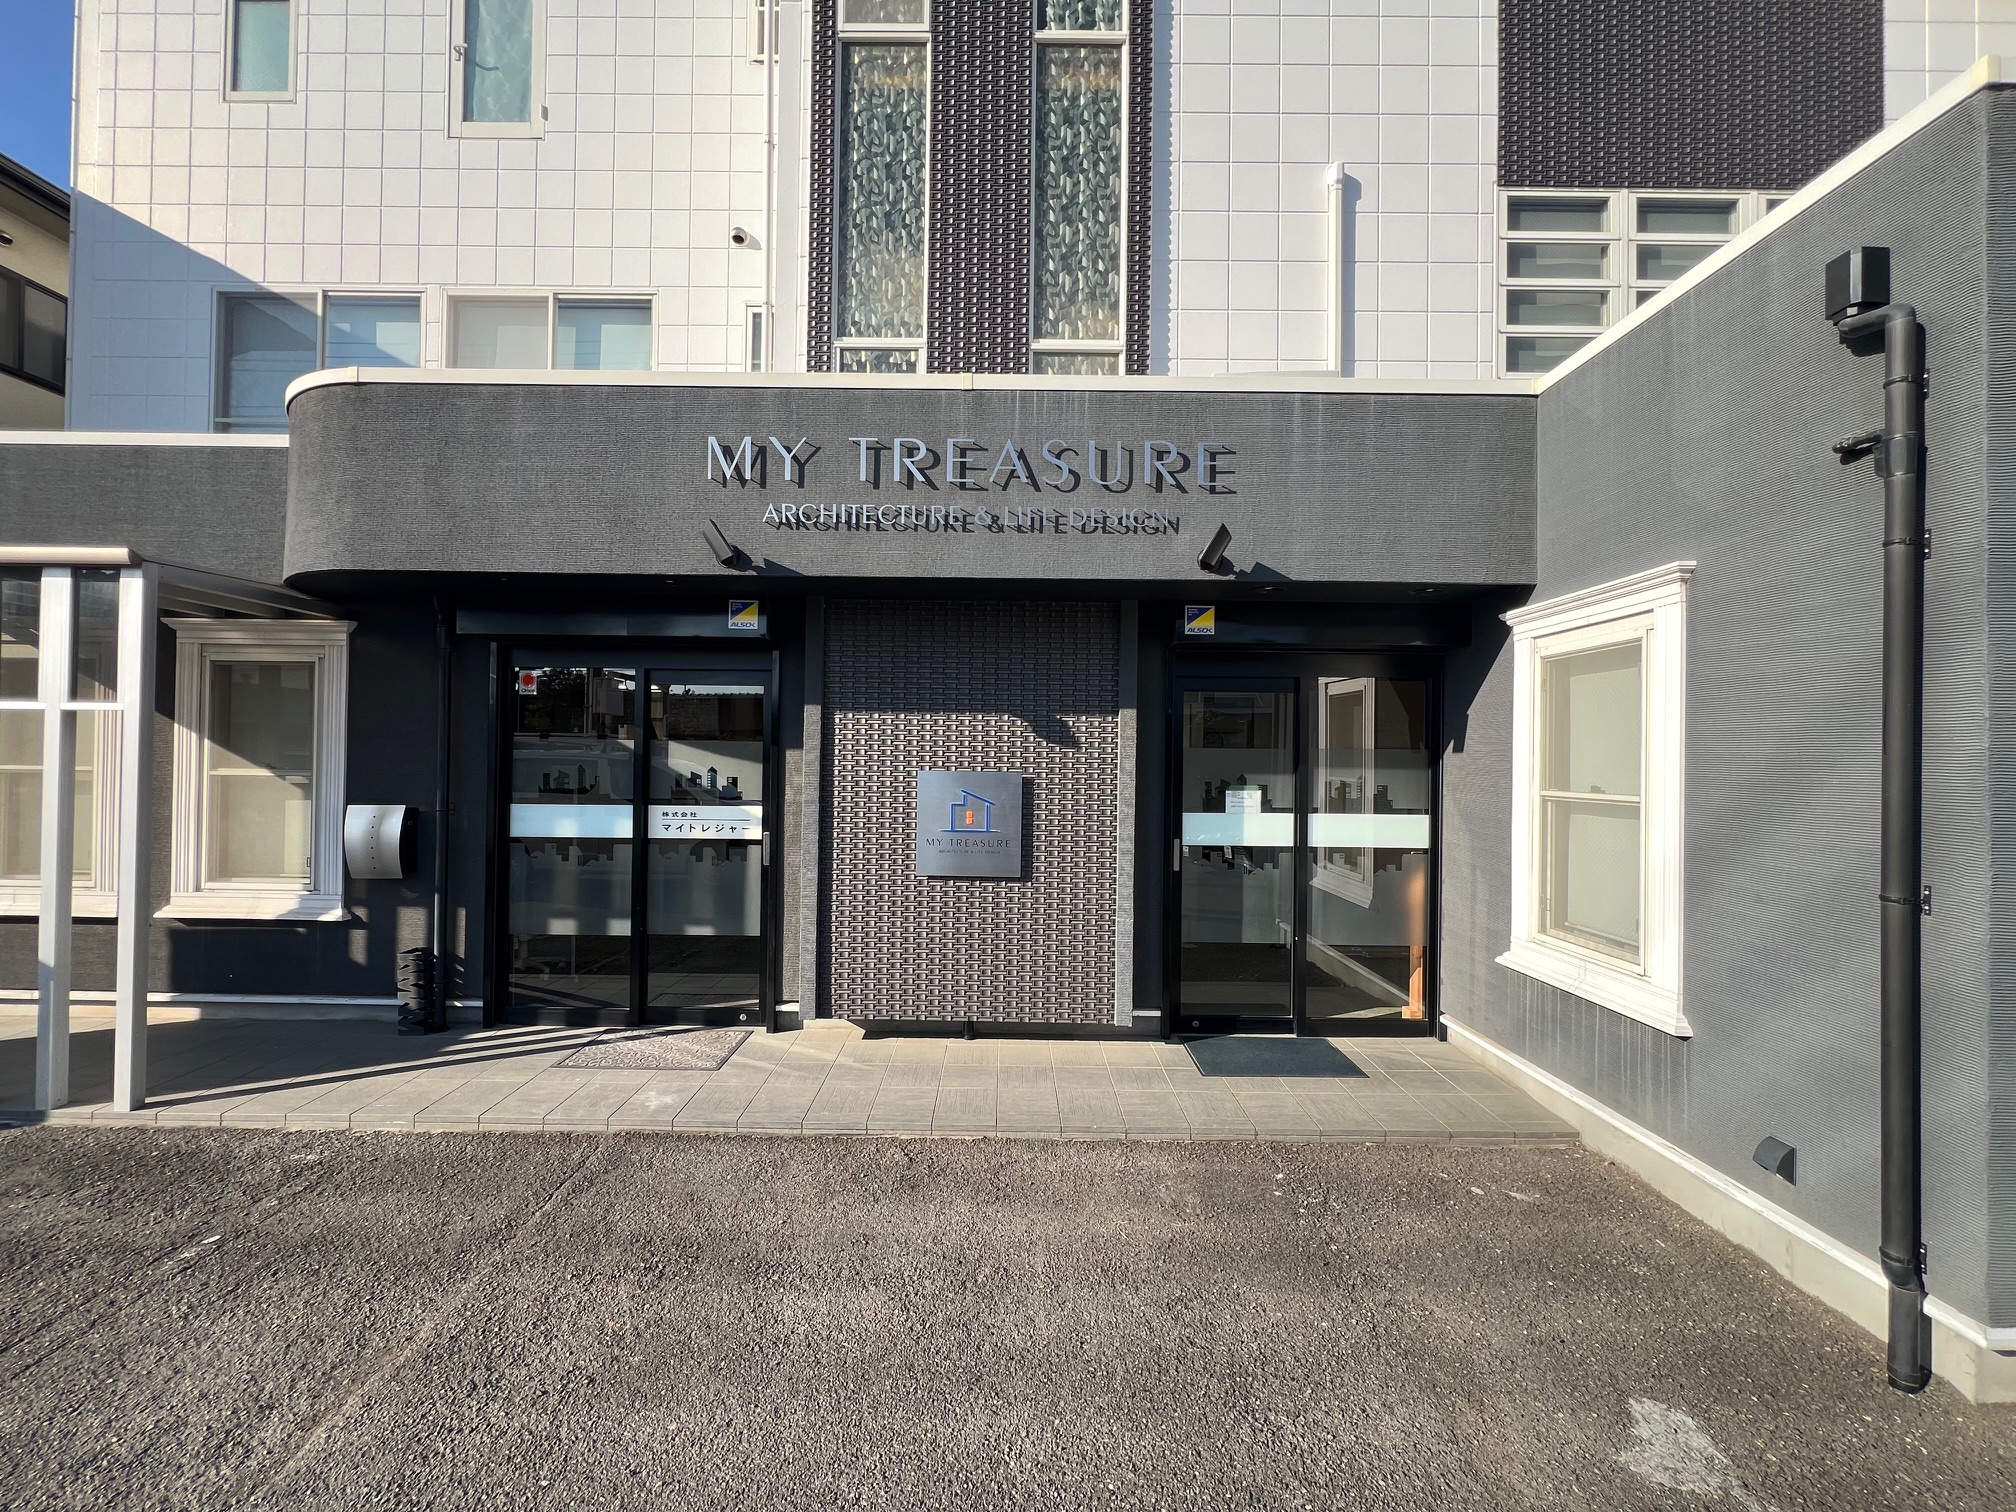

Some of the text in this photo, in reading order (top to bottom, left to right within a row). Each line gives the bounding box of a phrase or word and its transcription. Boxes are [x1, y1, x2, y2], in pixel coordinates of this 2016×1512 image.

[708, 437, 1223, 486] MY TREASURE
[763, 503, 1168, 527] ARCHITECTURE & LIFE DESIGN
[661, 823, 750, 833] マイトレジャー
[926, 838, 1011, 848] MY TREASURE
